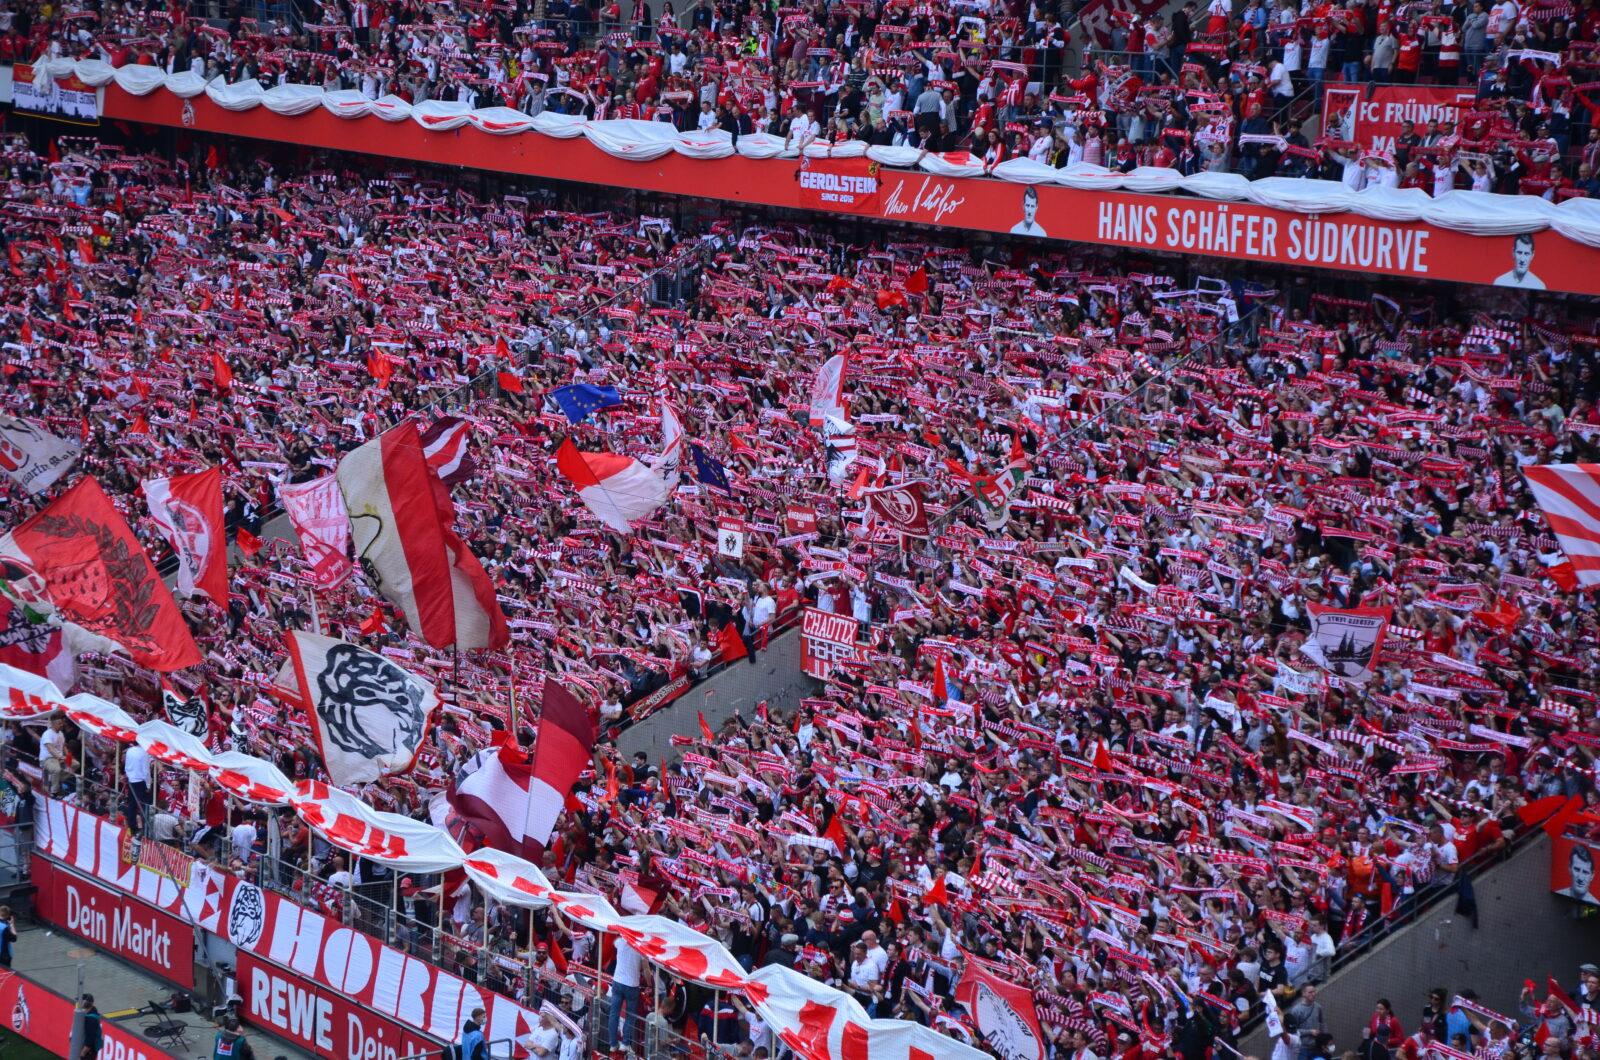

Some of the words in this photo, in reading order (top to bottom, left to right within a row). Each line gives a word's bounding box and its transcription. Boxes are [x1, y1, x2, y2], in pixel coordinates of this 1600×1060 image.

[1360, 102, 1379, 122] FC
[800, 172, 876, 194] GEROLSTEIN
[821, 192, 838, 202] SINCE
[840, 194, 854, 203] 2012
[1098, 202, 1158, 244] HANS
[1166, 204, 1278, 257] SCHÄFER
[1288, 214, 1430, 273] SÜDKURVE
[803, 611, 857, 645] CHAOTIX
[67, 885, 108, 944] Dein
[112, 906, 171, 969] Markt
[252, 966, 334, 1050] REWE
[348, 1012, 396, 1060] Dein
